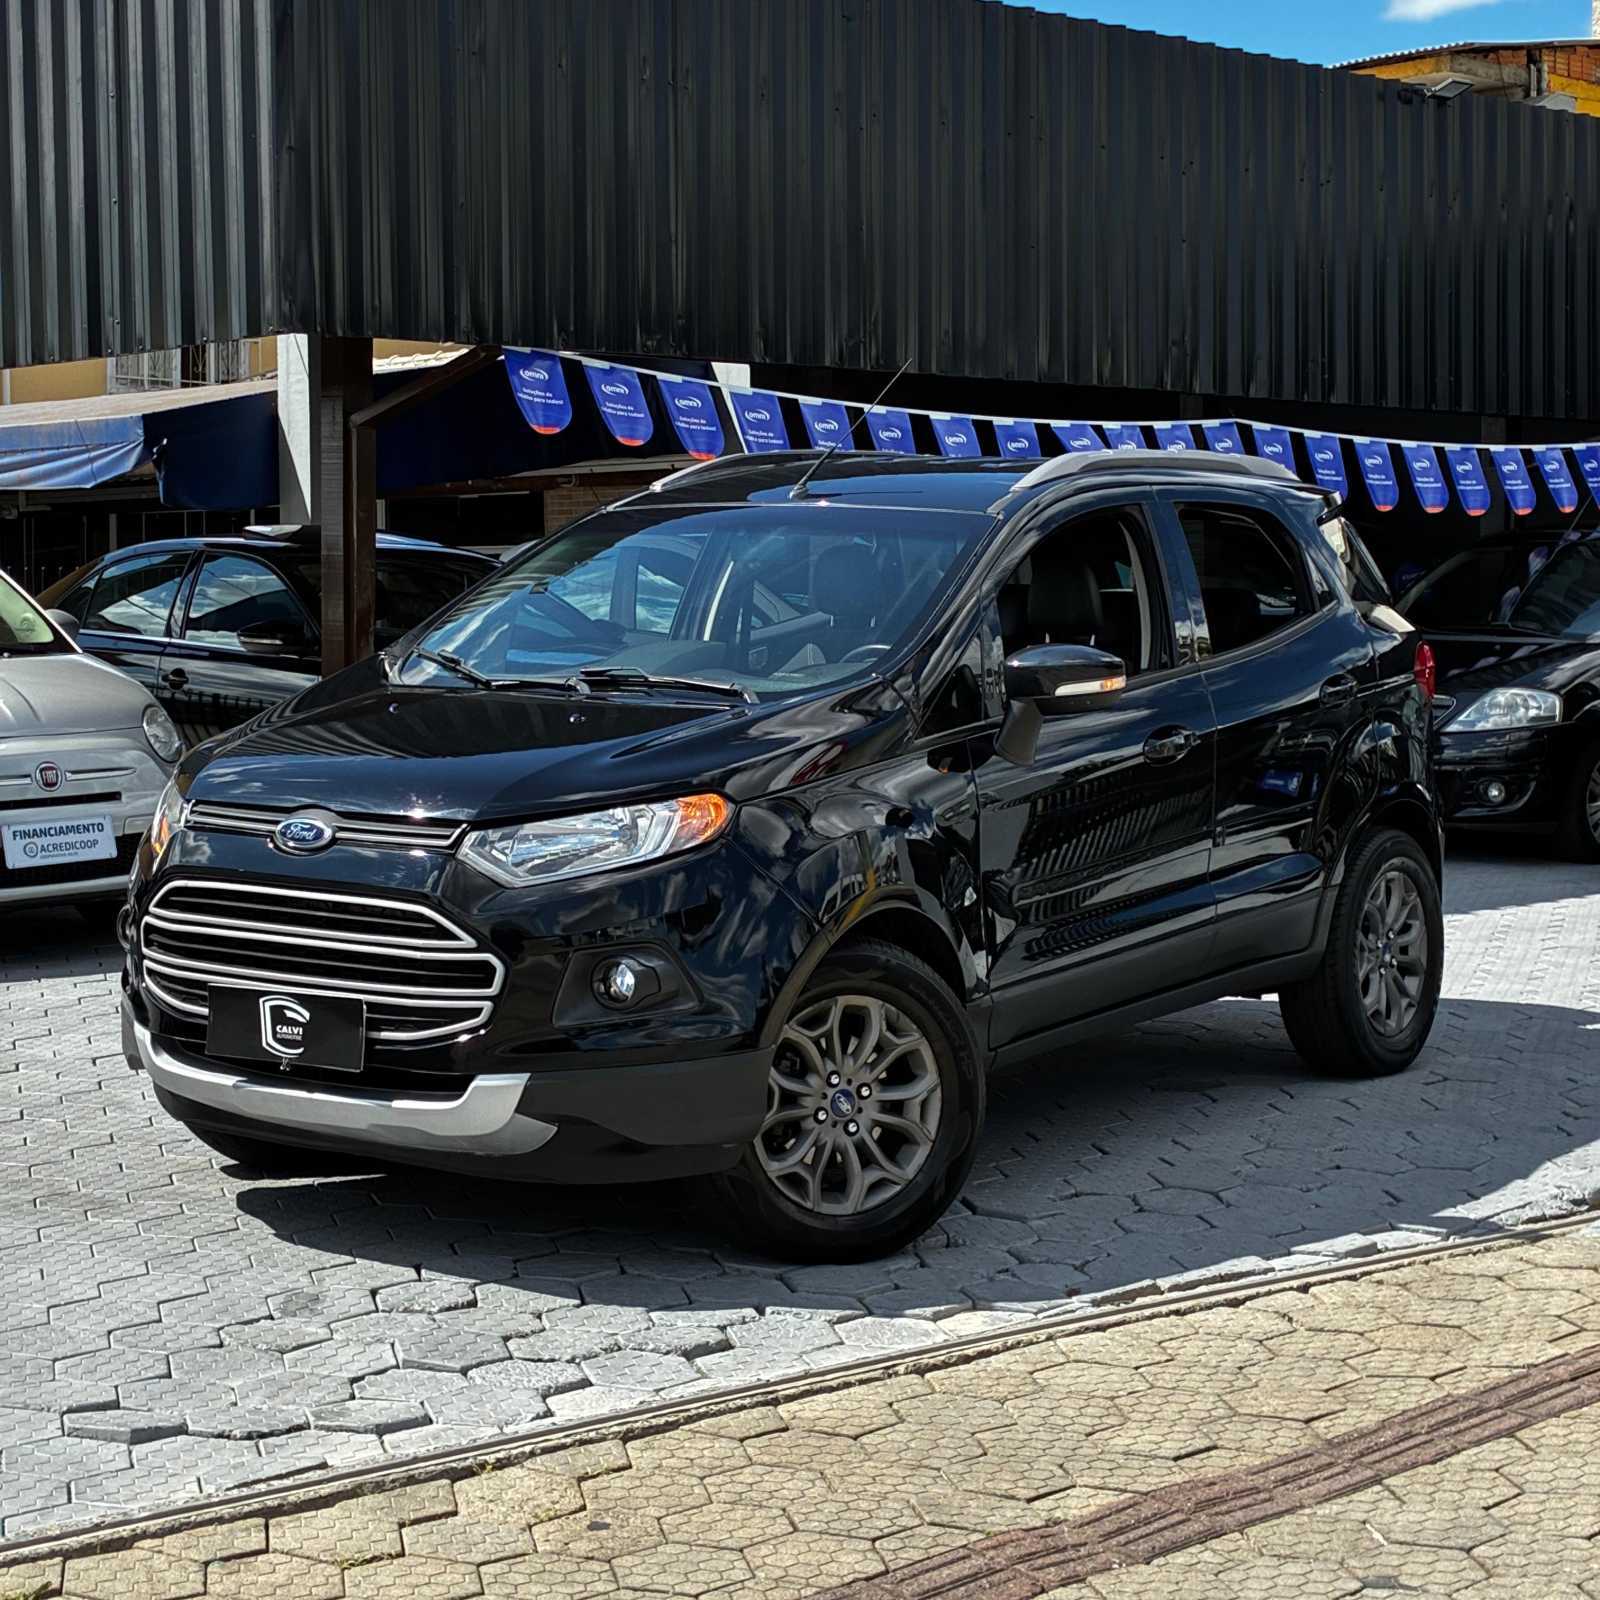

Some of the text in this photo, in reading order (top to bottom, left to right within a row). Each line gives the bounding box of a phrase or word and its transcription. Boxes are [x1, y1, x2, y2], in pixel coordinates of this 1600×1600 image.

[42, 770, 57, 783] FIAT
[12, 822, 104, 841] FINANCIAMENTO
[286, 823, 317, 840] Ford
[39, 839, 99, 854] ACREDICOOP
[276, 1024, 303, 1035] CALVI
